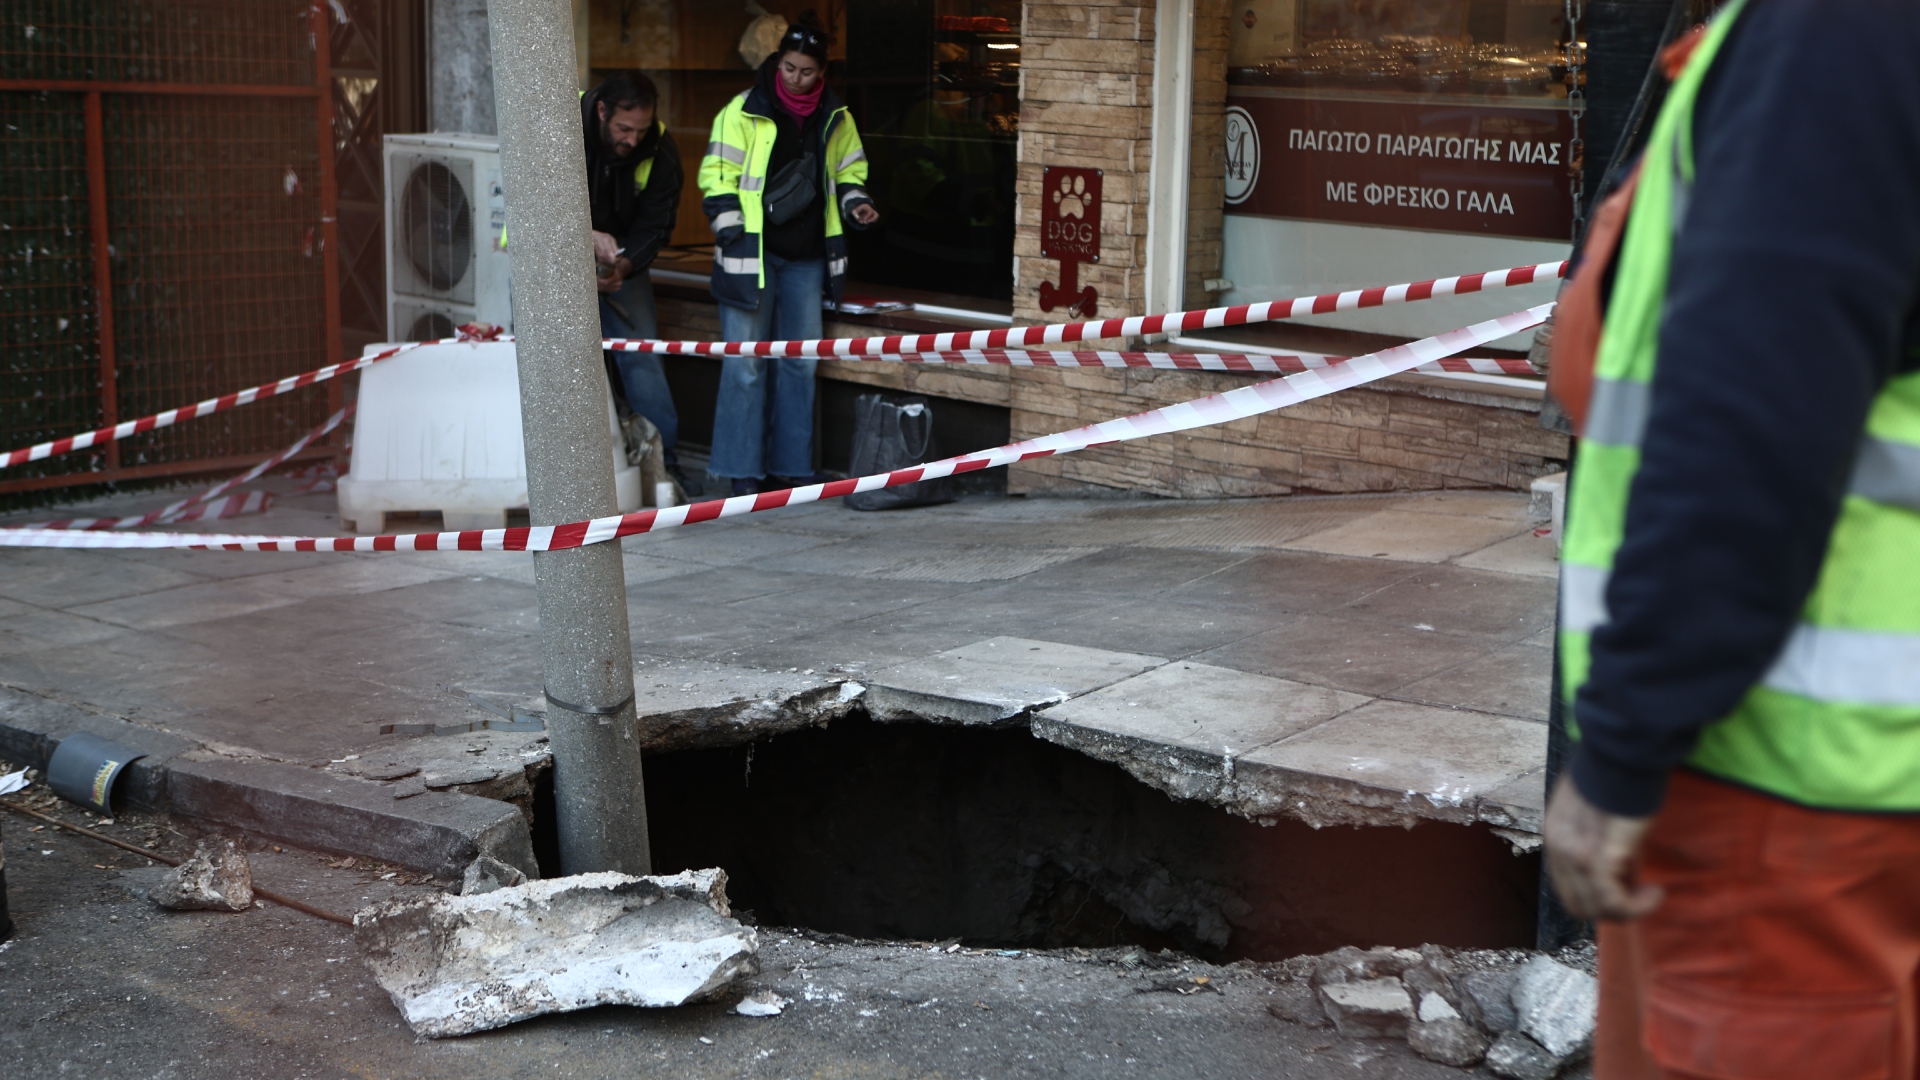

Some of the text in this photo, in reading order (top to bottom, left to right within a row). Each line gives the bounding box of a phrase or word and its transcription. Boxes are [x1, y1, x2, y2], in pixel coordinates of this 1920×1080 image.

[1288, 128, 1562, 165] ΠΑΓΩΤΟ ΠΑΡΑΓΩΓΗΣ ΜΑΣ
[1325, 180, 1515, 215] ΜΕ ΦΡΕΣΚΟ ΓΑΛΑ
[1048, 220, 1093, 243] DOG
[1048, 241, 1093, 255] PARKING
